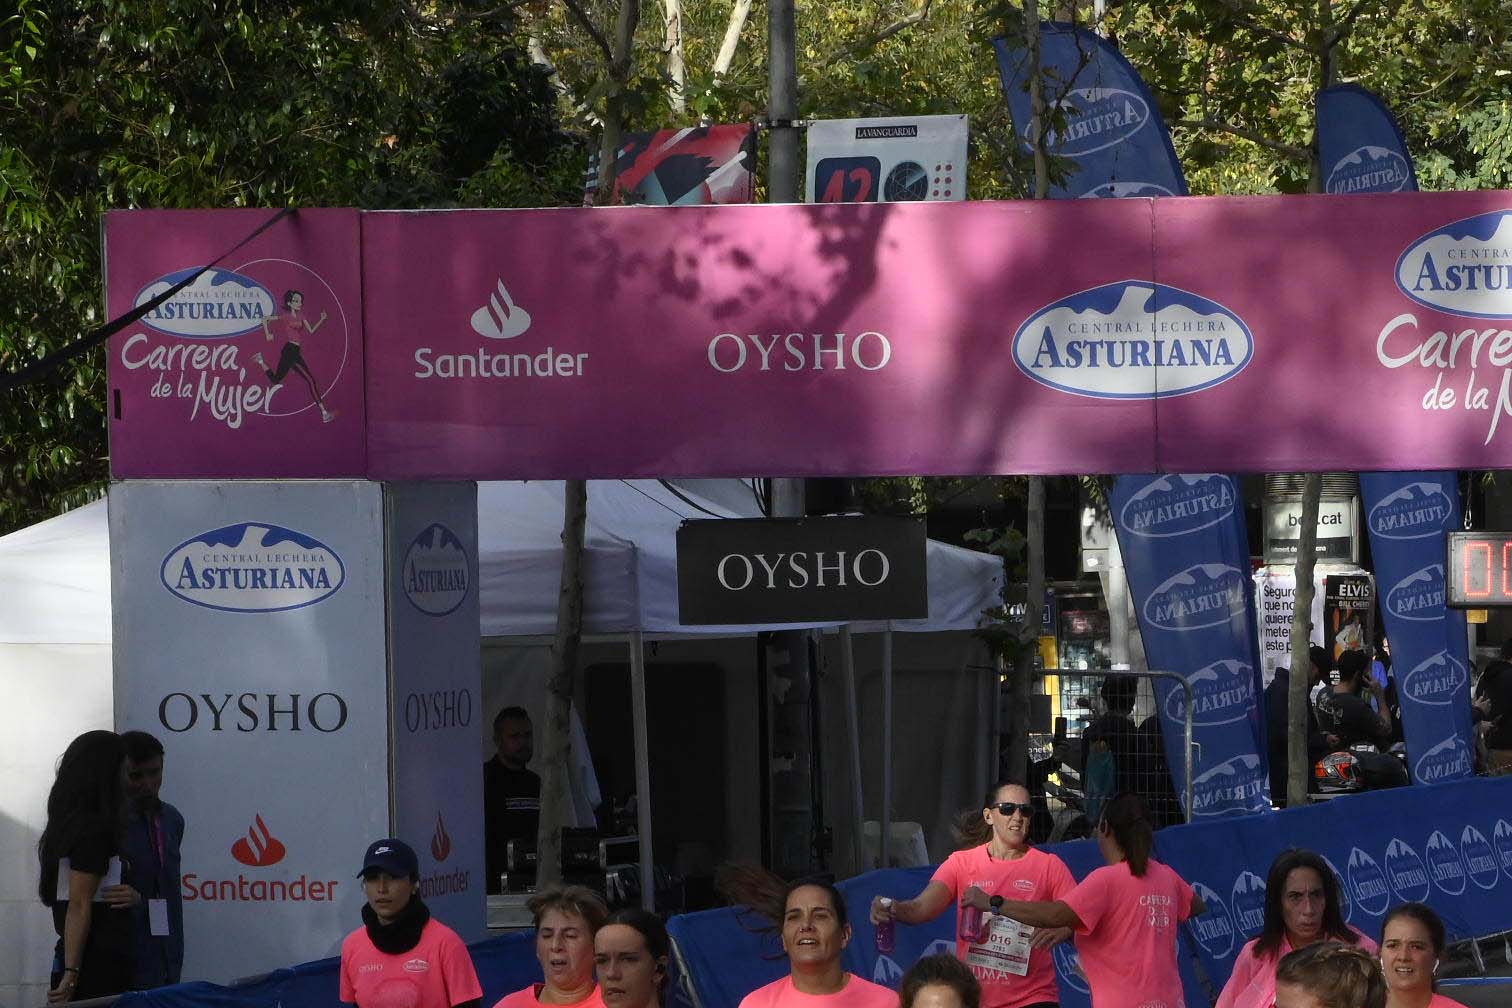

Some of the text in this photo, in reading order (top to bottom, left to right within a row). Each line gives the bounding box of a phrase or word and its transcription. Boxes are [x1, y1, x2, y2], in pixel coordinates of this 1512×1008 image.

[146, 292, 265, 321] ASTURIANA
[1068, 320, 1227, 334] CENTRAL LECHERA
[121, 333, 240, 371] Carrera
[414, 347, 589, 378] Santander
[708, 331, 892, 375] OYSHO
[1031, 326, 1235, 369] ASTURIANA
[150, 368, 283, 429] de la Mujer
[1422, 372, 1457, 411] de
[1465, 370, 1490, 410] la
[175, 556, 332, 590] ASTURIANA
[203, 553, 325, 564] CENTRAL LECHERA
[717, 548, 890, 592] OYSHO
[407, 560, 467, 594] ASTURIANA
[1339, 584, 1370, 597] ELVIS
[1264, 600, 1281, 613] que
[1265, 614, 1293, 627] quiere
[1266, 640, 1285, 652] este
[157, 692, 349, 733] OYSHO
[406, 688, 472, 734] OYSHO
[182, 873, 339, 901] Santander
[419, 868, 470, 900] antander
[990, 933, 1012, 946] 016
